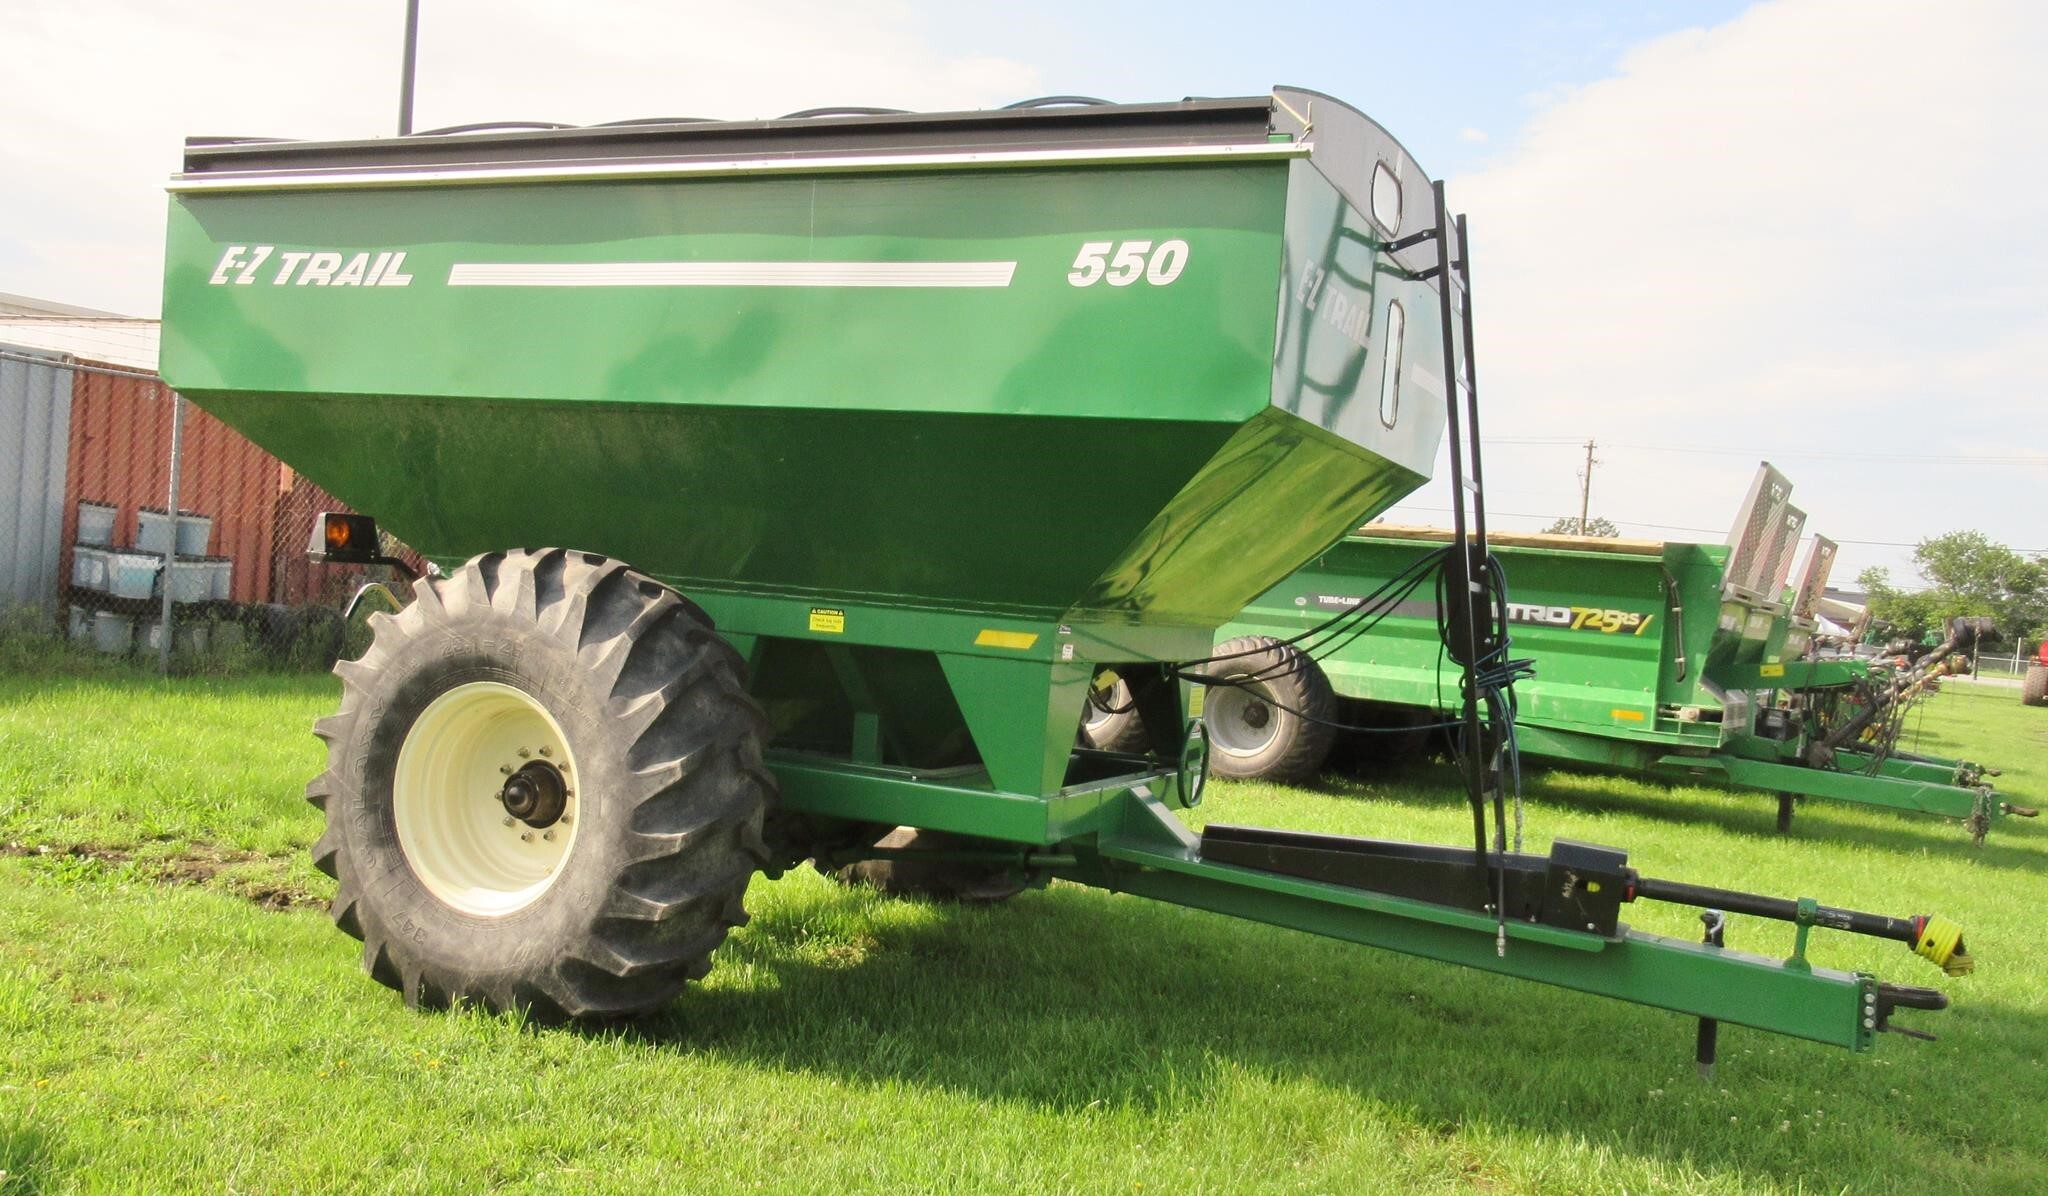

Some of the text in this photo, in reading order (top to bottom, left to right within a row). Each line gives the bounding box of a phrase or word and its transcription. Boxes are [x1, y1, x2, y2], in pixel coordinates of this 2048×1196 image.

[208, 246, 414, 287] E-Z TRAIL
[1067, 239, 1189, 287] 550
[1322, 284, 1371, 346] TRAIL
[816, 608, 839, 616] CAUTION
